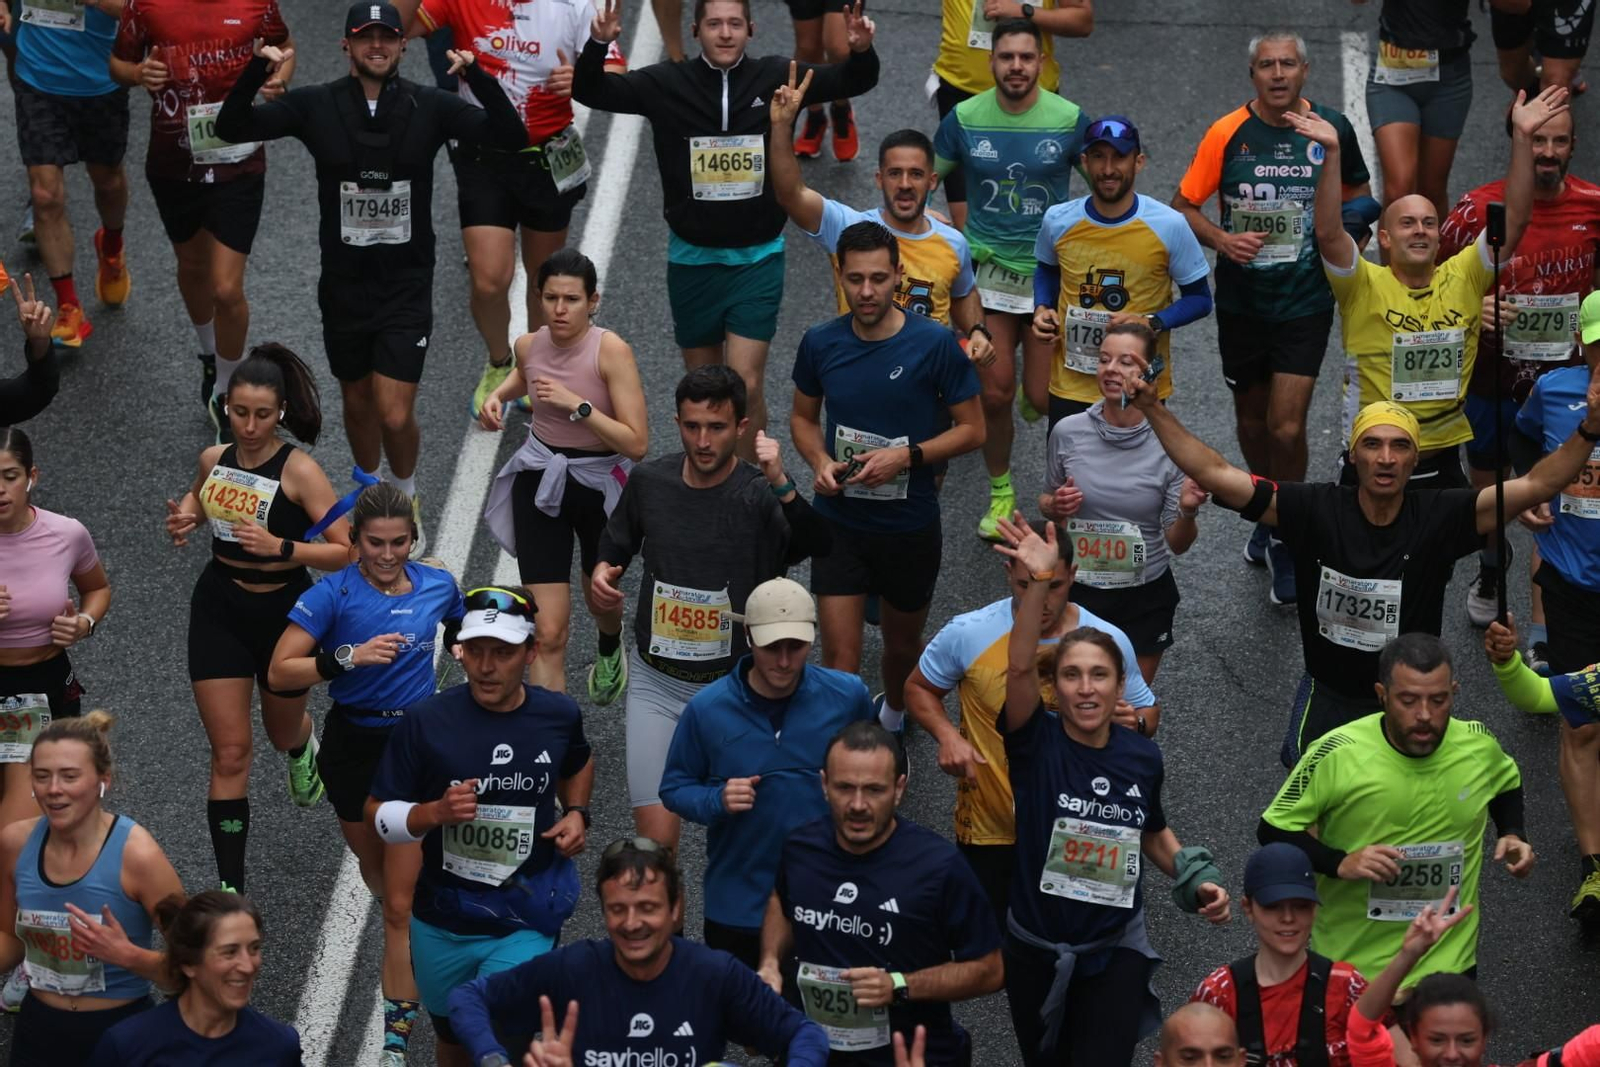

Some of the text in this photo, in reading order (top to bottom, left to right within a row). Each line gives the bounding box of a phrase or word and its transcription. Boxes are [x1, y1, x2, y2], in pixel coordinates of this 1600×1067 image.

[491, 35, 542, 56] oliva
[697, 152, 754, 173] 14665
[1254, 165, 1302, 178] emec
[346, 198, 401, 218] 17948
[1241, 215, 1287, 235] 7396
[1516, 311, 1564, 332] 9279
[1404, 347, 1453, 371] 8723
[206, 483, 261, 517] 14233
[1076, 537, 1127, 561] 9410
[1324, 587, 1385, 621] 17325
[658, 602, 721, 631] 14585
[495, 750, 511, 760] JIG
[450, 772, 534, 795] syhello
[1057, 792, 1132, 822] sayhello
[451, 824, 520, 853] 10085
[1063, 838, 1118, 870] 9711
[838, 887, 855, 899] JIG
[793, 905, 873, 939] sayhello
[632, 1020, 651, 1031] JIG
[584, 1046, 679, 1067] sayhello
